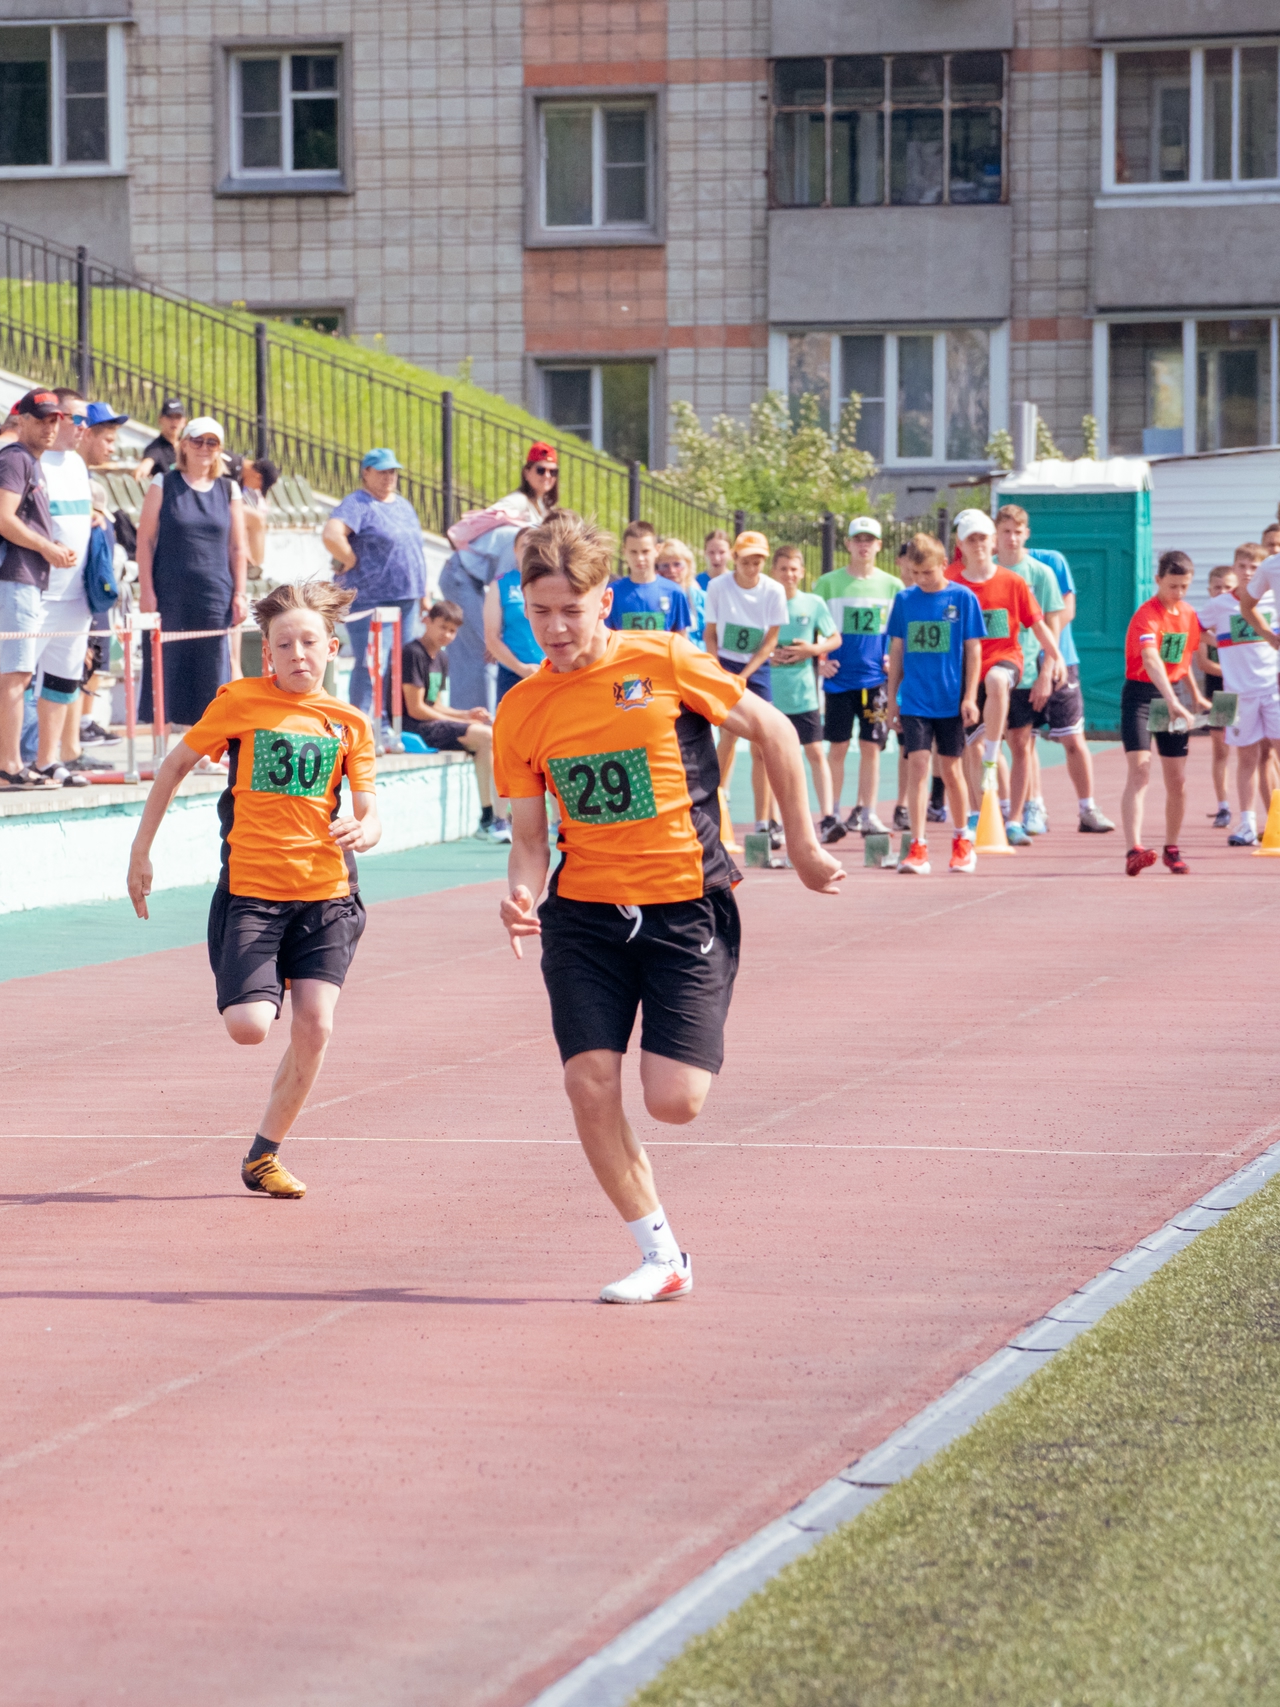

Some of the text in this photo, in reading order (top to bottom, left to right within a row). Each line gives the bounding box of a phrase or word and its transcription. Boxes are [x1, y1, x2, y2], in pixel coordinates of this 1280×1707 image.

[851, 610, 874, 632] 12
[736, 628, 750, 650] 8
[913, 625, 942, 648] 49
[1164, 636, 1182, 659] 11
[268, 738, 322, 790] 30
[568, 760, 632, 815] 29
